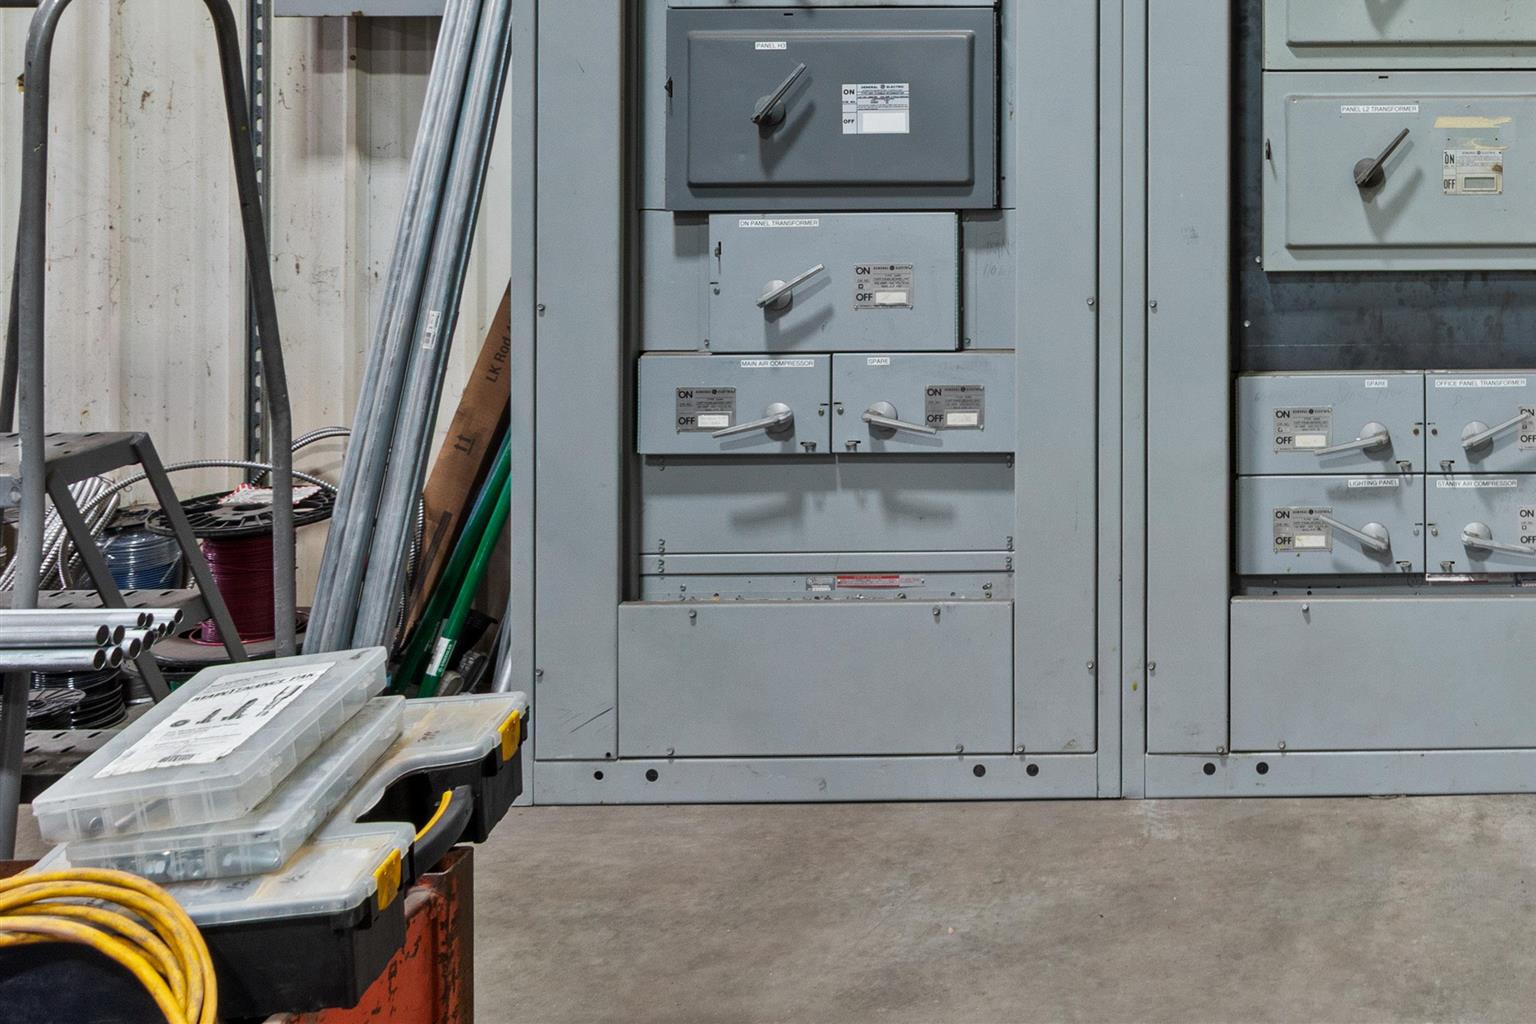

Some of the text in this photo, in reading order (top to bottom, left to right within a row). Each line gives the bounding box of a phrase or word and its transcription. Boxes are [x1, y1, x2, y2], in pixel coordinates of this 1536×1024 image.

[1444, 153, 1455, 165] ON
[1443, 178, 1456, 189] OFF
[855, 266, 871, 275] ON
[856, 293, 873, 302] OFF
[486, 364, 502, 383] LK
[678, 390, 693, 399] ON
[927, 388, 942, 397] ON
[927, 414, 944, 423] OFF
[1275, 410, 1290, 419] ON
[678, 416, 695, 425] OFF
[1275, 436, 1293, 445] OFF
[1520, 434, 1536, 443] OFF
[1275, 510, 1290, 519] ON
[1519, 509, 1535, 518] ON
[1275, 536, 1292, 545] OFF
[1520, 535, 1536, 544] OFF
